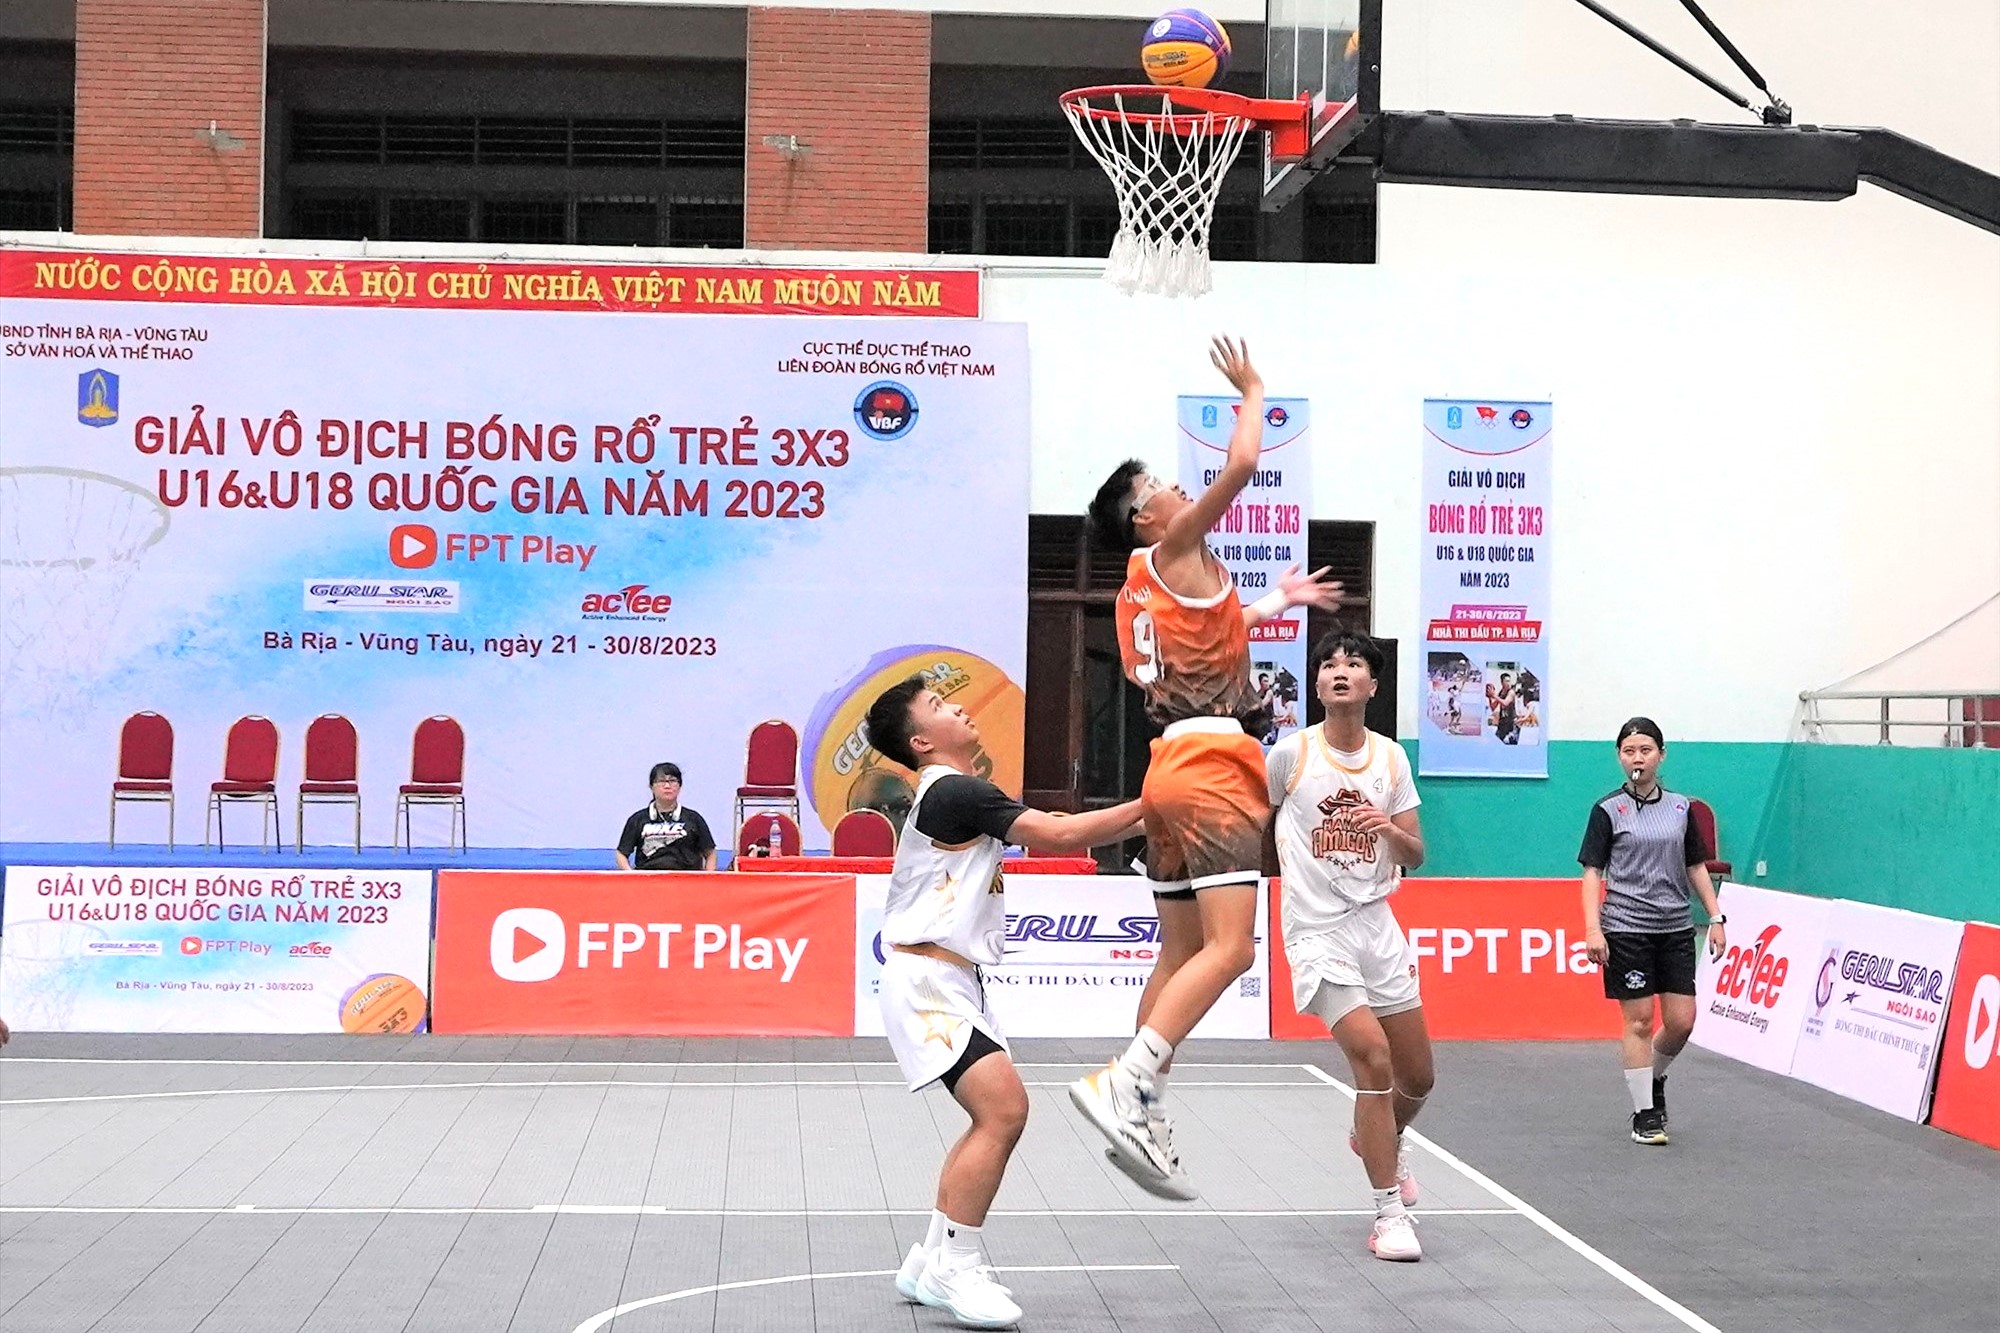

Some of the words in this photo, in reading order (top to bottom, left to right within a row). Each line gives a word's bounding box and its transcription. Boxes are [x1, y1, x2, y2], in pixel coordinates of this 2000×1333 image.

[34, 256, 121, 290] NƯỚC
[131, 258, 219, 298] CỘNG
[228, 260, 297, 295] HÒA
[304, 264, 350, 296] XÃ
[360, 264, 417, 303] HỘI
[427, 264, 492, 299] CHỦ
[503, 269, 602, 302] NGHĨA
[611, 270, 686, 309] VIỆT
[695, 277, 764, 304] NAM
[773, 272, 862, 306] MUÔN
[872, 274, 942, 306] NĂM
[0, 325, 34, 339] BND
[76, 324, 94, 340] BÀ
[99, 327, 122, 342] RỊA
[134, 326, 177, 341] VŨNG
[180, 326, 208, 342] TÀU
[5, 343, 26, 357] SỞ
[29, 344, 58, 357] VĂN
[98, 344, 117, 359] VÀ
[121, 343, 149, 360] THỂ
[152, 347, 193, 360] THAO
[803, 342, 833, 357] CỤC
[836, 339, 863, 355] THỂ
[867, 343, 898, 358] DỤC
[901, 341, 928, 357] THỂ
[931, 344, 971, 358] THAO
[778, 358, 808, 373] LIÊN
[812, 359, 855, 374] ĐOÀN
[860, 359, 900, 375] BÓNG
[905, 359, 925, 375] RỔ
[928, 361, 958, 378] VIỆT
[961, 363, 995, 377] NAM
[134, 404, 225, 455] GIẢI
[241, 409, 302, 457] VÔ
[317, 418, 427, 465] ĐỊCH
[446, 413, 577, 462] BÓNG
[594, 413, 661, 464] RỔ
[670, 415, 759, 466] TRẺ
[771, 428, 849, 468] 3X3
[158, 468, 353, 511] U16&U18
[368, 466, 497, 513] QUỐC
[510, 475, 589, 515] GIA
[604, 469, 709, 517] NĂM
[725, 479, 825, 519] 2023
[1275, 504, 1300, 534] 3X3
[1429, 499, 1465, 533] BÓNG
[1518, 505, 1543, 536] 3X3
[445, 533, 514, 563] FPT
[521, 535, 597, 572] Play
[1224, 544, 1242, 561] U18
[1275, 545, 1291, 561] GIA
[1436, 545, 1454, 560] U16
[1457, 547, 1464, 560] &
[1467, 546, 1485, 561] U18
[1488, 541, 1515, 563] QUỐC
[1518, 547, 1534, 562] GIA
[1241, 571, 1267, 588] 2023
[1484, 572, 1510, 588] 2023
[1454, 627, 1469, 638] THI
[264, 631, 293, 649] Bà
[301, 632, 337, 654] Rịa
[359, 632, 418, 655] Vũng
[426, 633, 474, 655] Tàu,
[484, 633, 543, 657] ngày
[551, 634, 577, 653] 21
[603, 636, 717, 656] 30/8/2023
[1311, 827, 1378, 864] AMIGOS
[37, 872, 83, 896] GIẢI
[92, 874, 122, 896] VÔ
[130, 878, 186, 899] ĐỊCH
[195, 875, 262, 897] BÓNG
[271, 874, 306, 898] RỔ
[310, 875, 354, 899] TRẺ
[361, 881, 401, 900] 3X3
[48, 903, 147, 921] U16&U18
[155, 899, 221, 921] QUỐC
[228, 903, 267, 922] GIA
[275, 901, 329, 923] NĂM
[337, 905, 388, 924] 2023
[1005, 915, 1098, 942] ERU
[206, 940, 235, 952] FPT
[239, 940, 272, 956] Play
[577, 922, 683, 969] FPT
[694, 923, 809, 983] Play
[1110, 950, 1160, 960] NG
[1408, 928, 1508, 974] FPT
[1520, 928, 1598, 974] Pla
[244, 982, 255, 990] 21
[266, 982, 314, 991] 30/8/2023
[1024, 975, 1058, 986] THI
[1110, 973, 1151, 986] CHÍ
[1915, 1008, 1937, 1024] SAO
